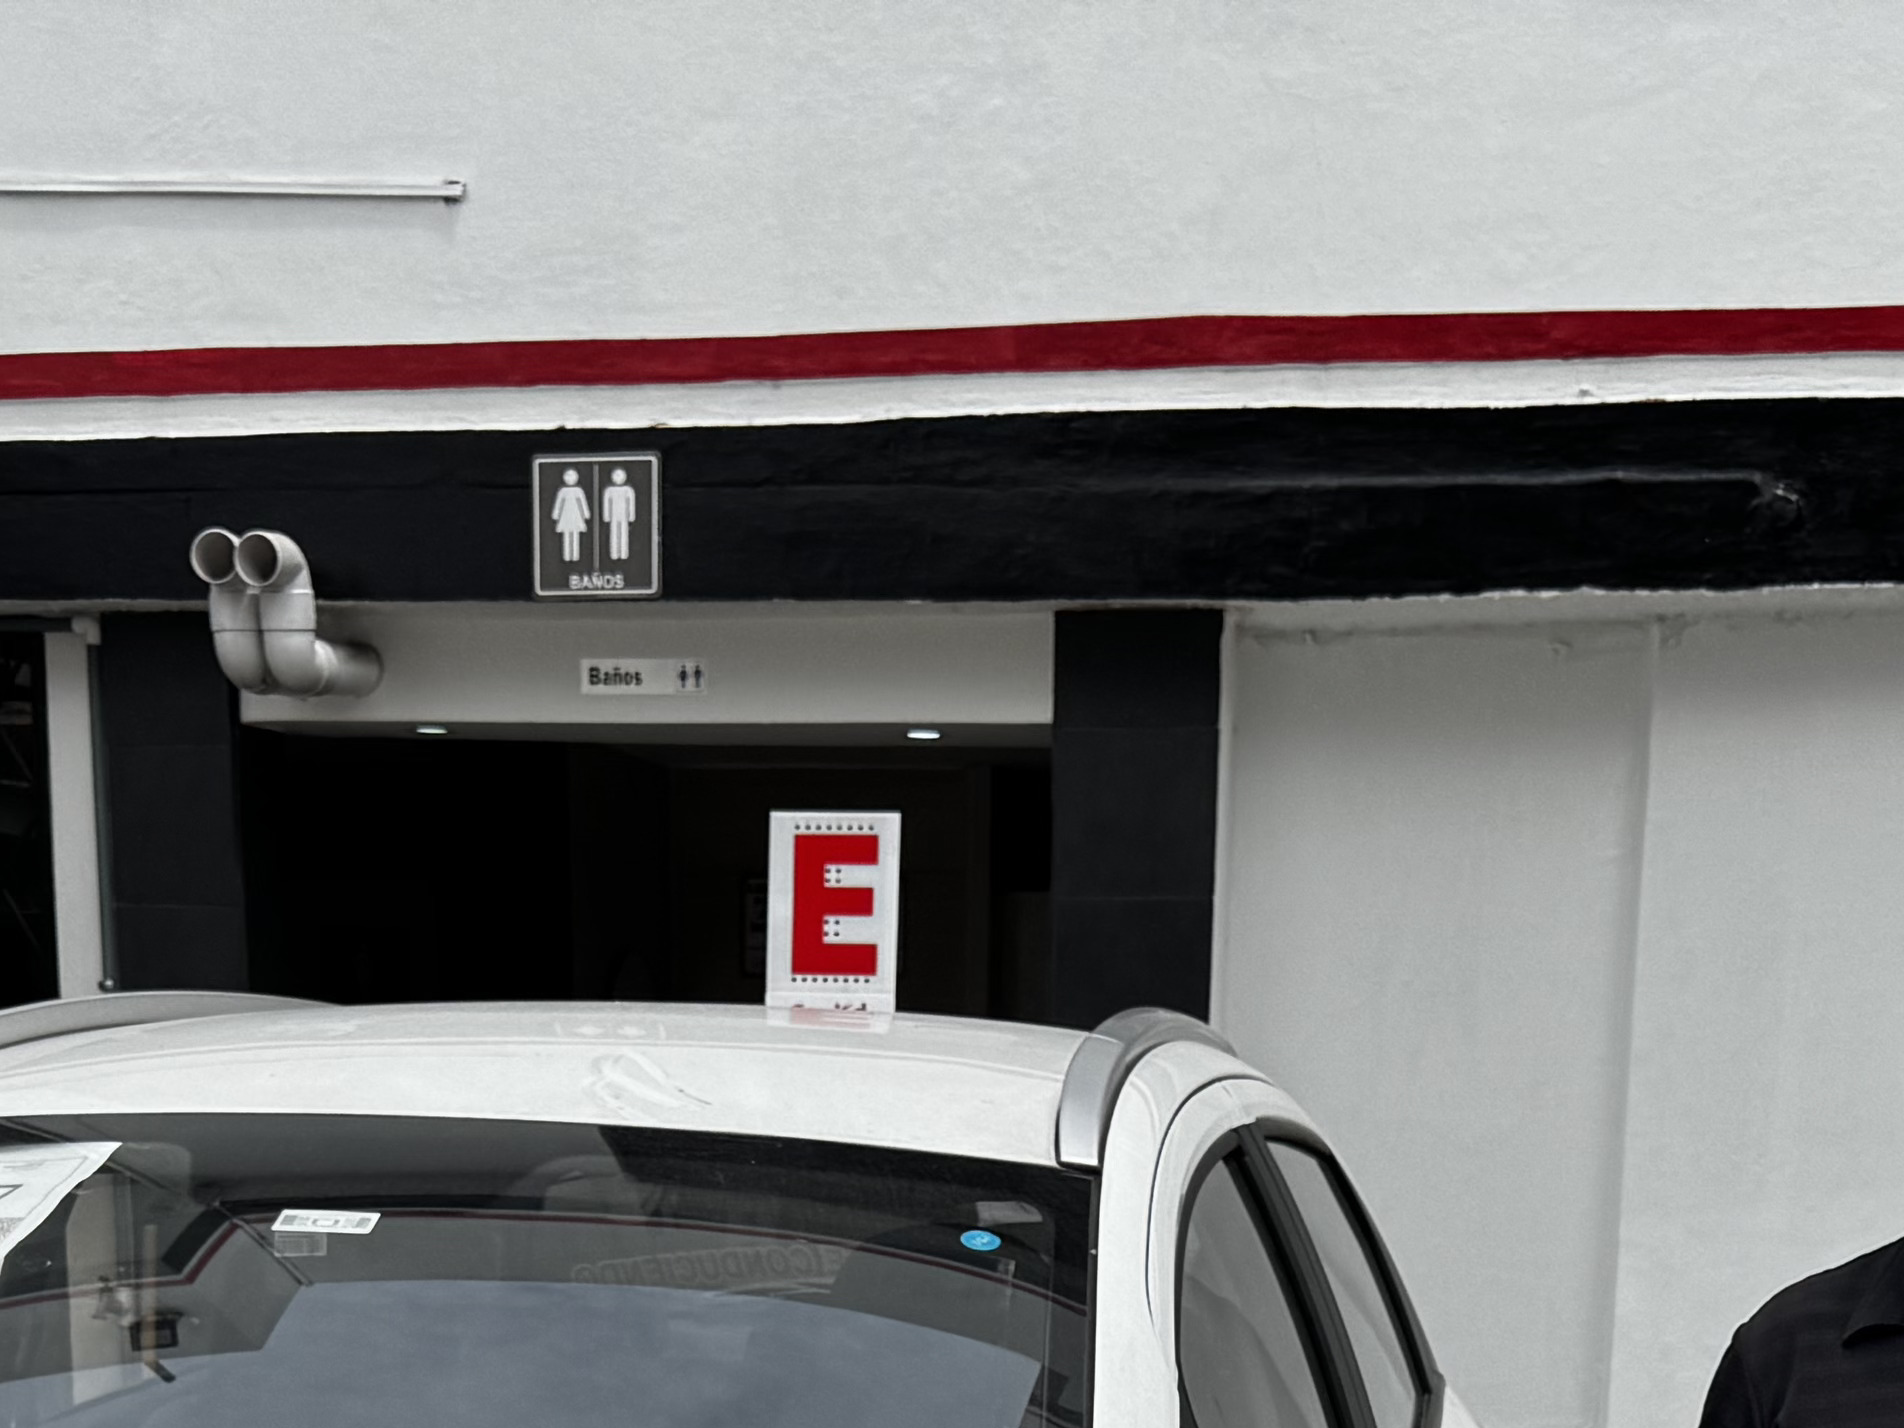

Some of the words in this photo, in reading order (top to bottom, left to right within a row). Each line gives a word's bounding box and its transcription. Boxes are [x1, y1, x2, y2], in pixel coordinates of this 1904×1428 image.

[568, 570, 626, 590] BAÑOS
[587, 665, 644, 688] Baños
[791, 834, 879, 976] E
